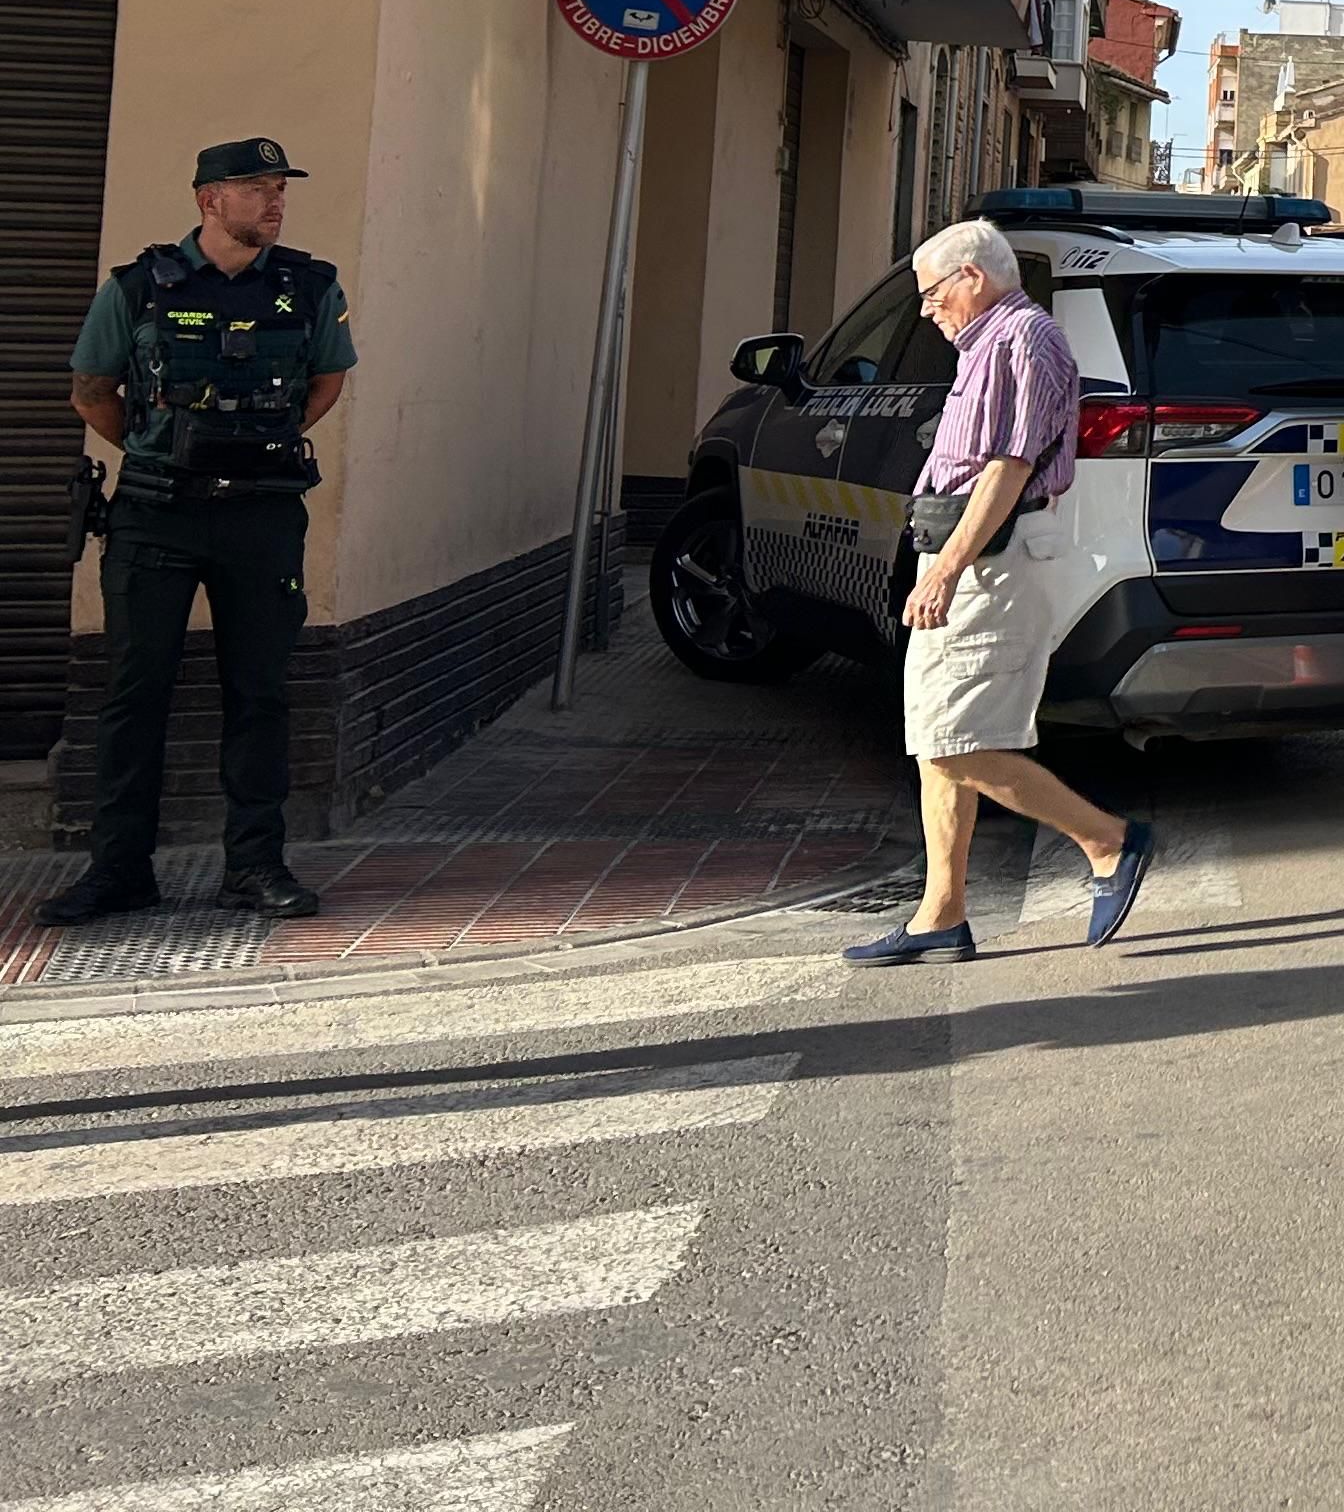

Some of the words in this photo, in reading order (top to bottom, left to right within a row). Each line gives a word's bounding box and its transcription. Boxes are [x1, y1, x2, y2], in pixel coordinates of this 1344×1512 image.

[1071, 249, 1110, 269] 112
[167, 311, 214, 320] GUARDIA
[177, 318, 206, 326] CIVIL
[859, 387, 926, 417] LOCAL
